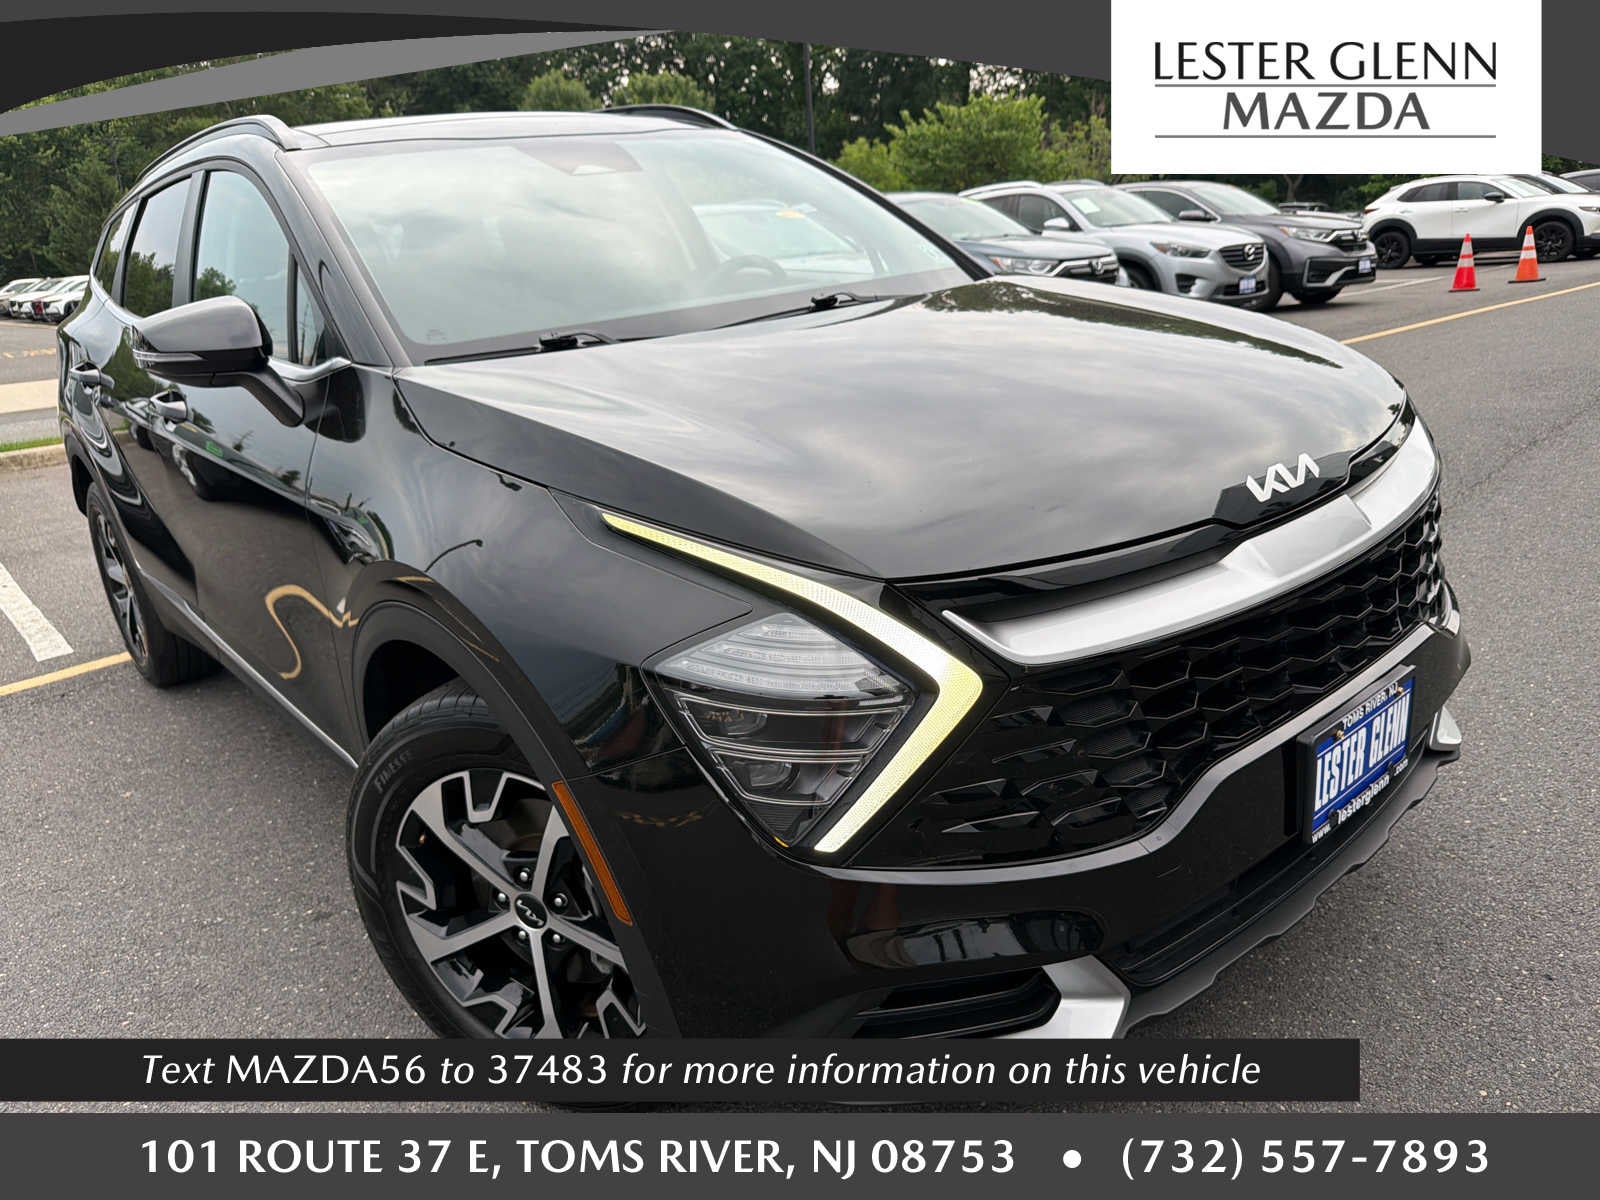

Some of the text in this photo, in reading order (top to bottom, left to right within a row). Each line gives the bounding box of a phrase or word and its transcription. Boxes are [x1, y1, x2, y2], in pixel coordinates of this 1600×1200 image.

[1246, 452, 1320, 503] KIA
[1342, 707, 1365, 730] TOMS
[1388, 682, 1399, 698] NJ
[1314, 692, 1411, 812] LESTER GLENN
[1337, 775, 1390, 825] lesterglenn
